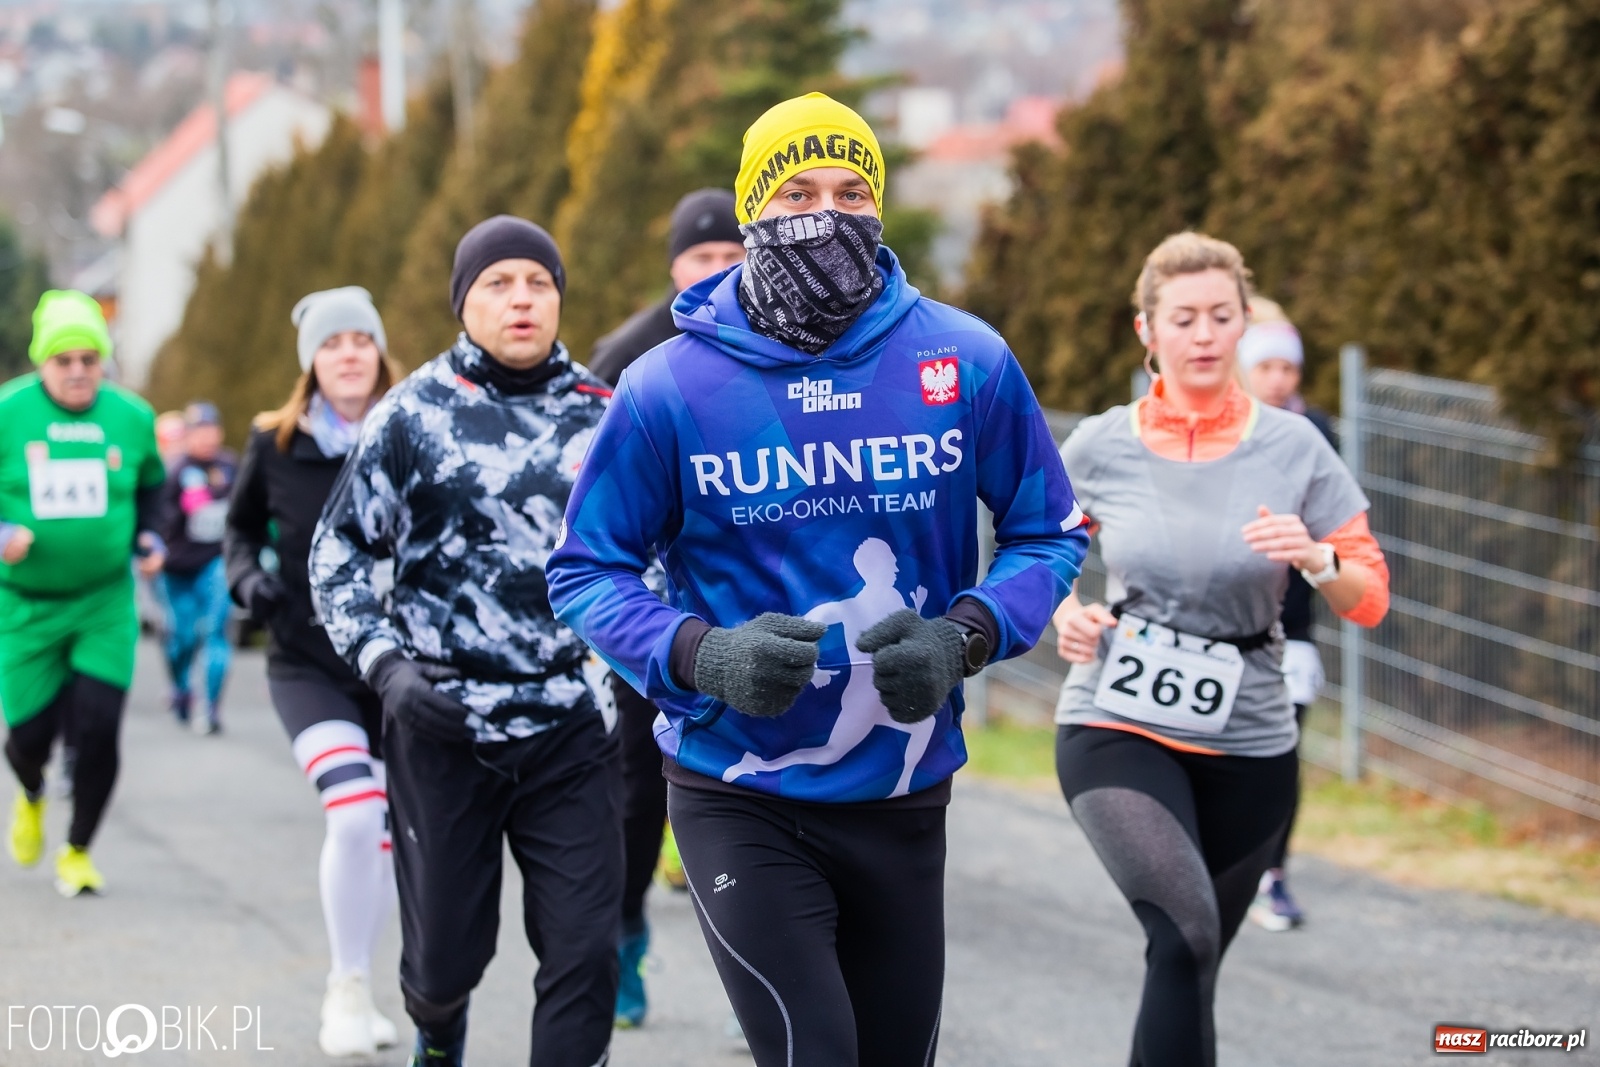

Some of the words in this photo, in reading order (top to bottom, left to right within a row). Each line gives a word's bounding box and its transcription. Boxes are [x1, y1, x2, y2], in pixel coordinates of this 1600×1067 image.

[917, 346, 958, 358] POLAND
[690, 428, 963, 496] RUNNERS
[731, 497, 864, 525] EKO-OKNA
[868, 489, 937, 513] TEAM
[1110, 655, 1223, 715] 269
